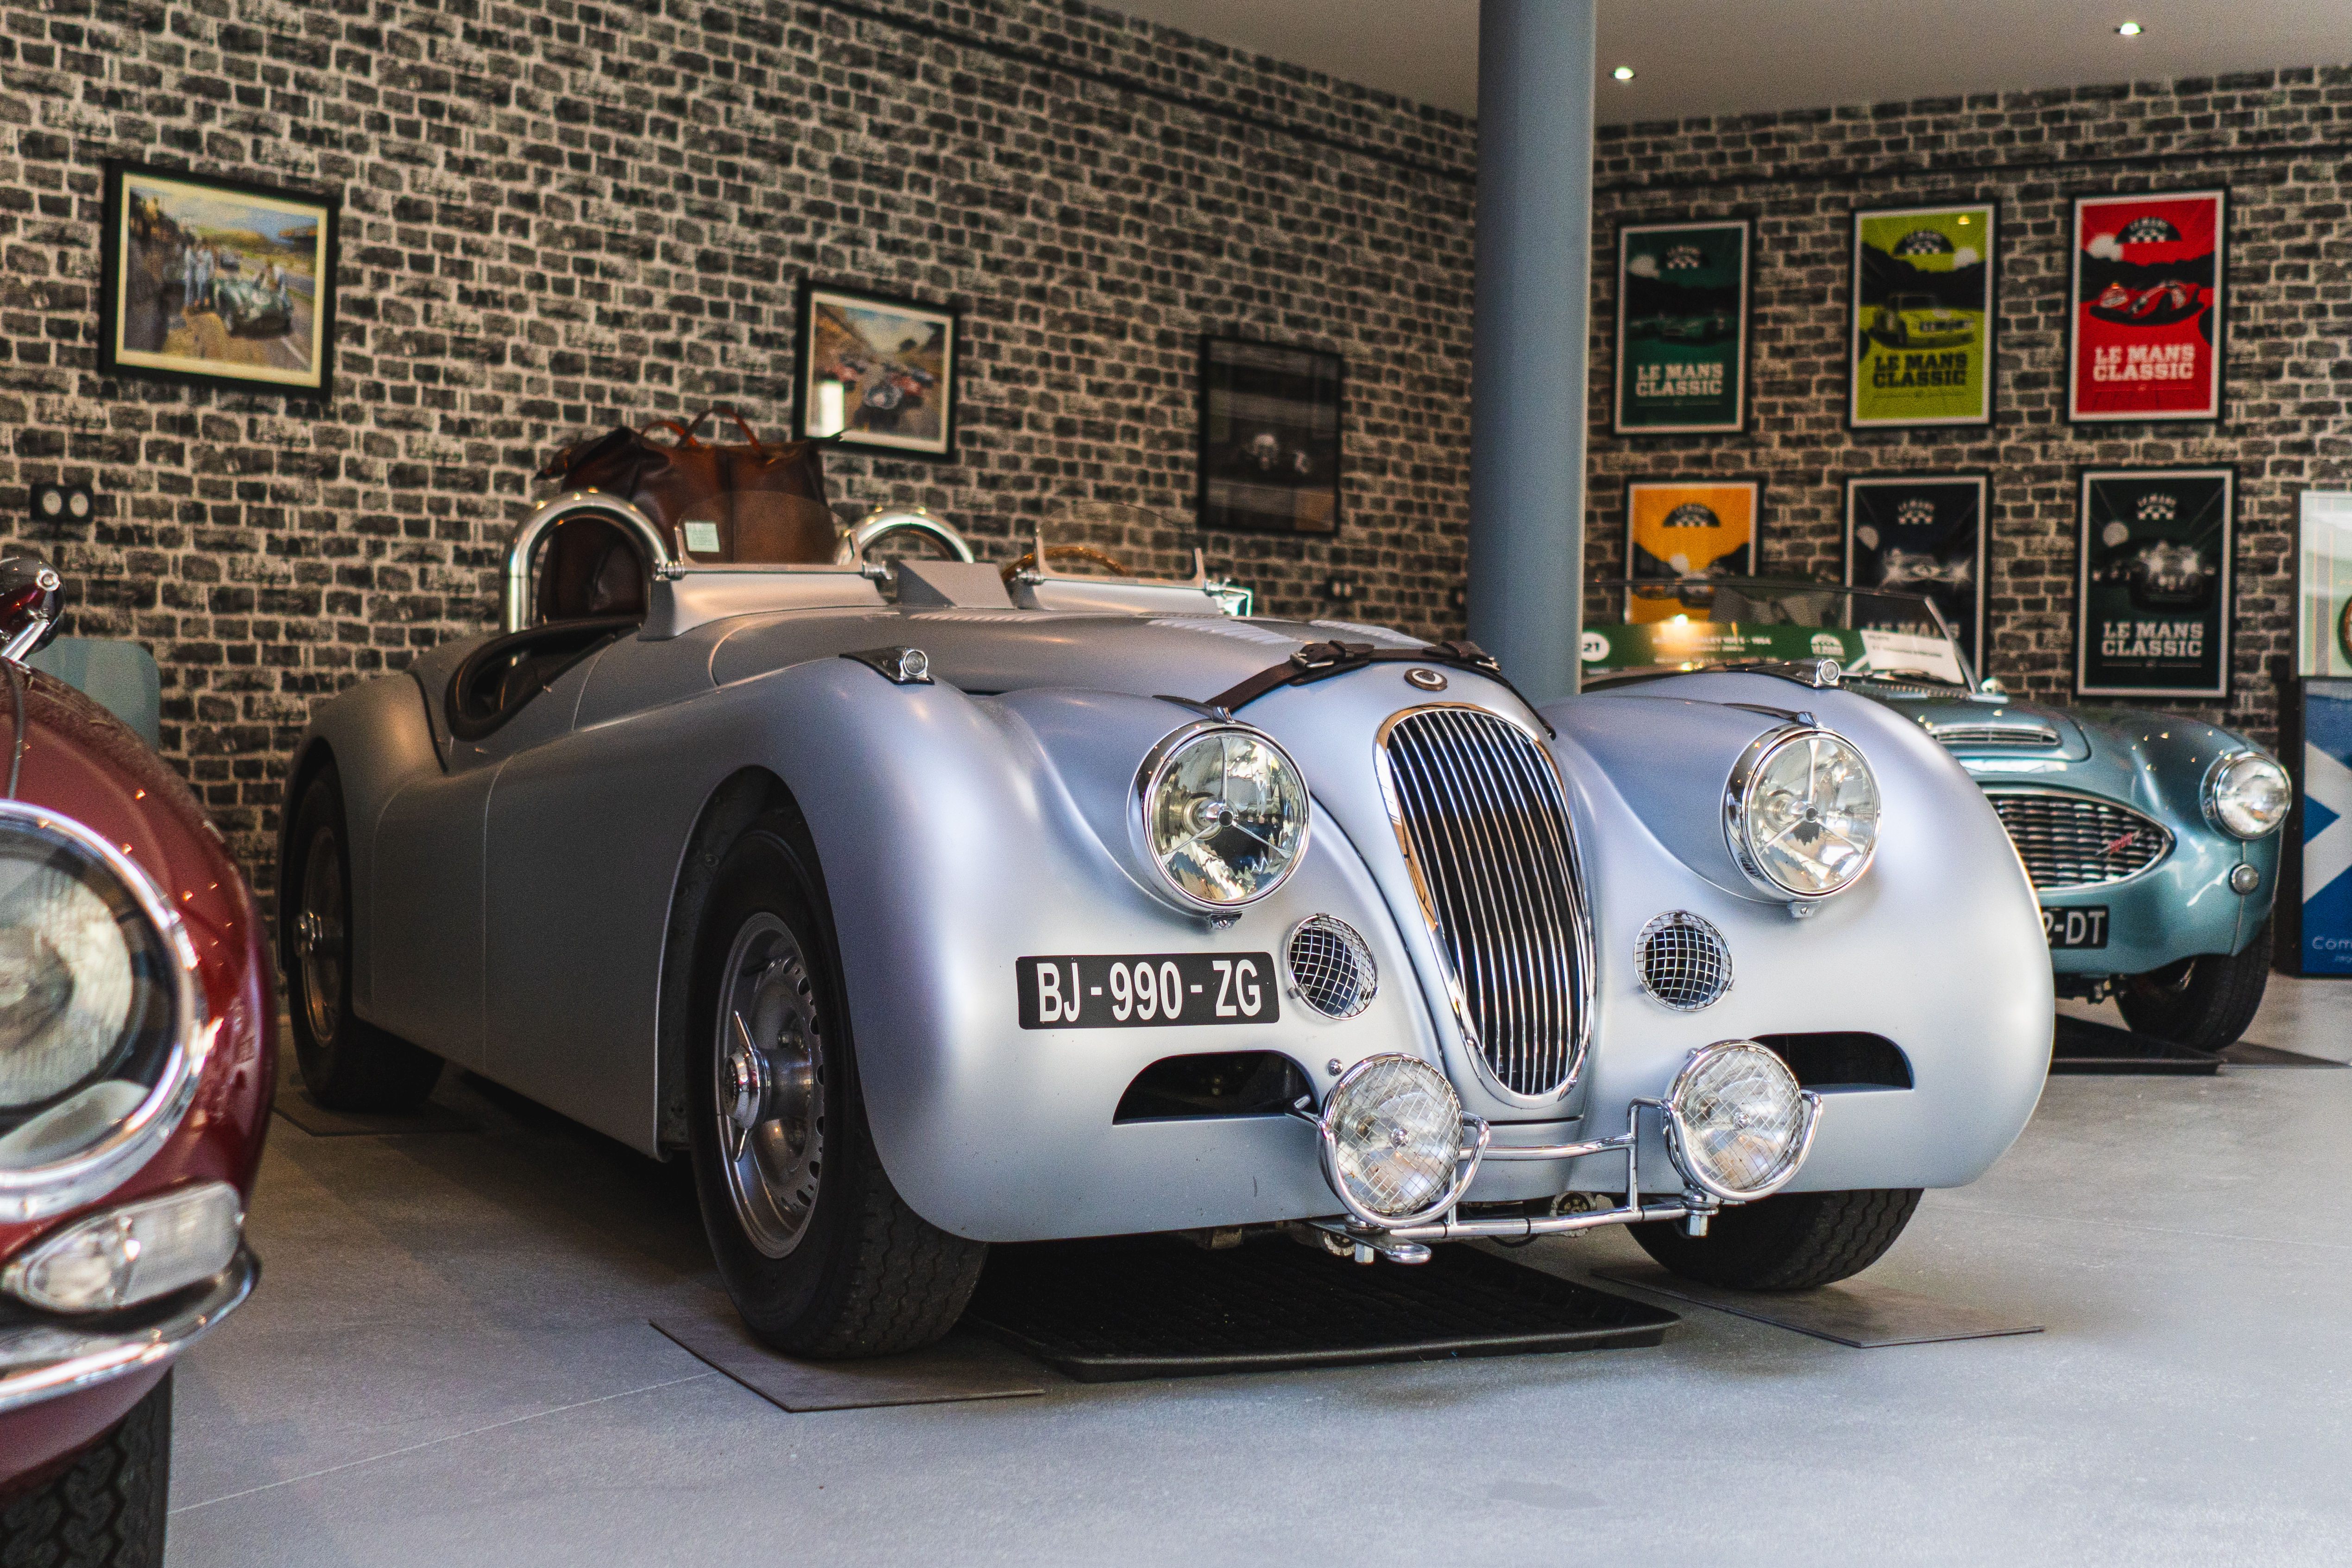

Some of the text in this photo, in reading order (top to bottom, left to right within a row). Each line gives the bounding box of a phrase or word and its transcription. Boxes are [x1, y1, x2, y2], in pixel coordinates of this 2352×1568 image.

[1875, 353, 1967, 370] LE MANS
[2094, 343, 2195, 364] LE MANS
[1638, 363, 1723, 380] LE MANS
[1873, 370, 1966, 387] CLASSIC
[2093, 363, 2194, 382] CLASSIC
[1636, 380, 1722, 396] CLASSIC
[2103, 621, 2203, 638] LE MANS
[2101, 640, 2202, 656] CLASSIC
[1037, 959, 1261, 1022] BJ-990-ZG
